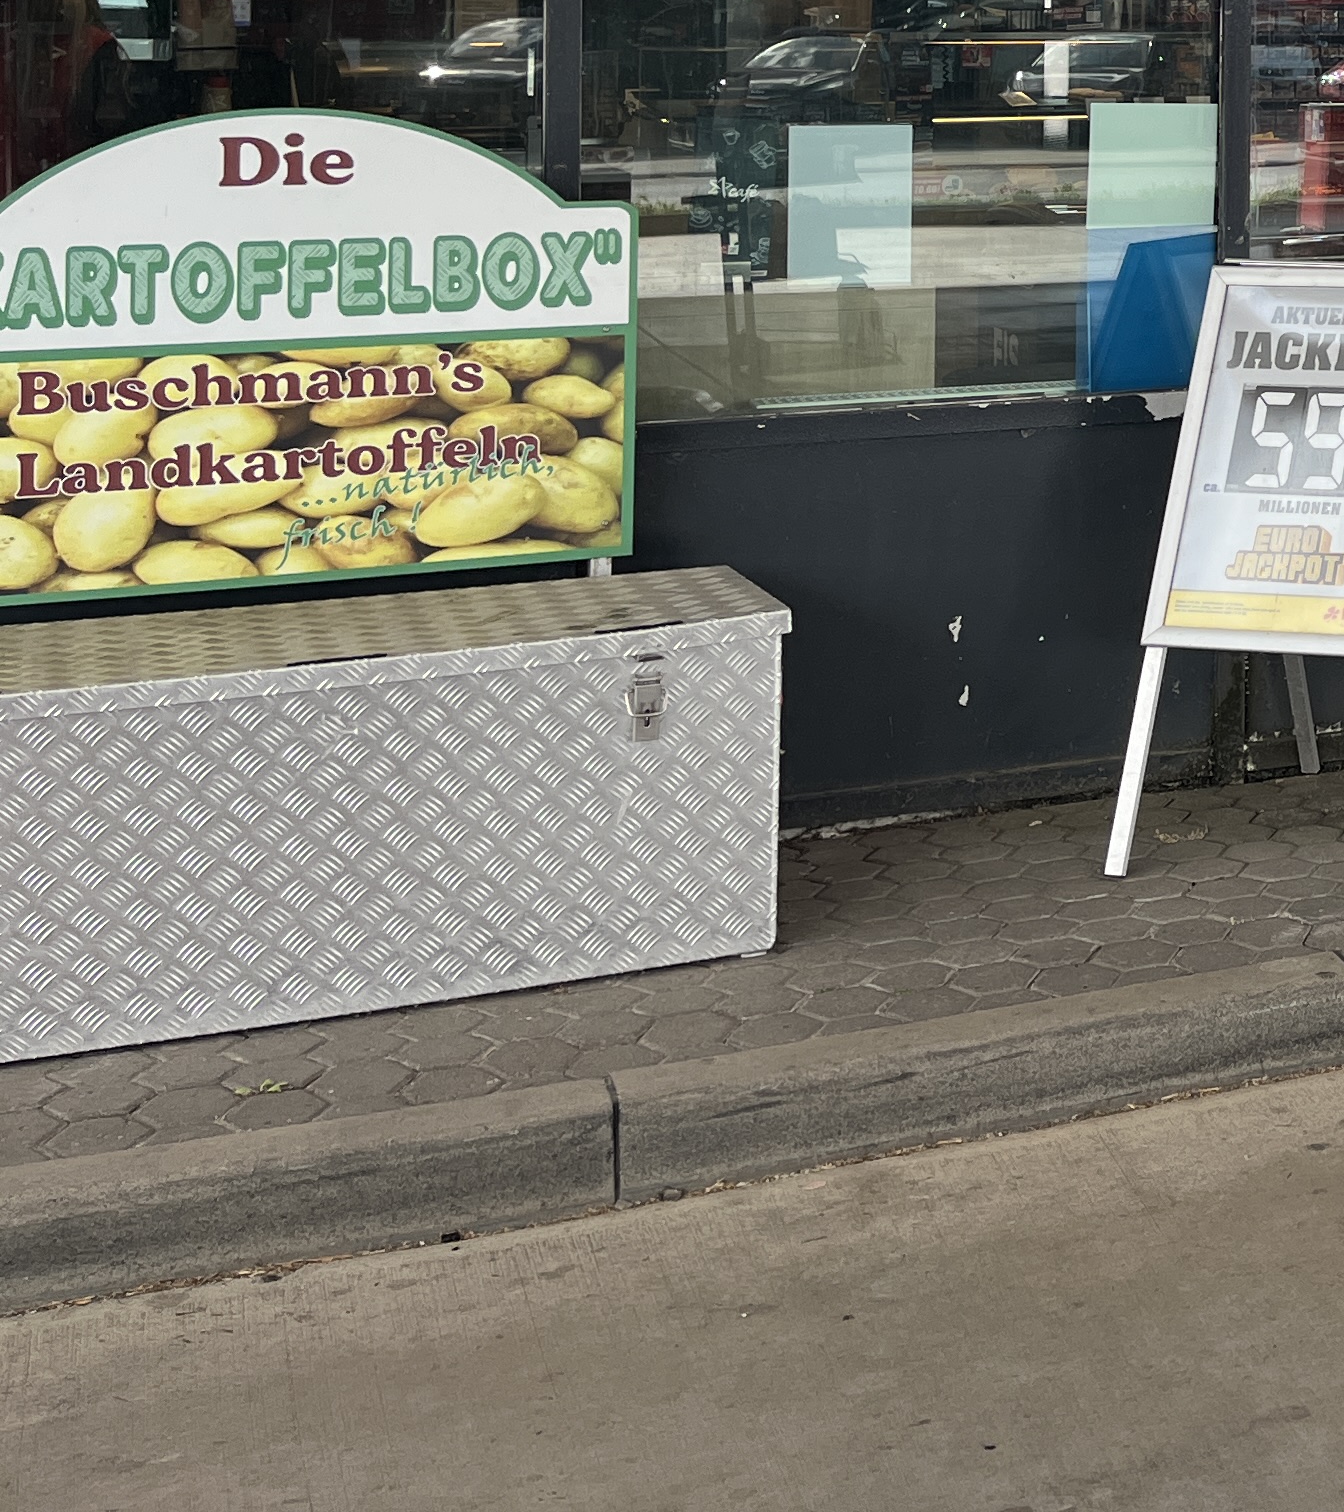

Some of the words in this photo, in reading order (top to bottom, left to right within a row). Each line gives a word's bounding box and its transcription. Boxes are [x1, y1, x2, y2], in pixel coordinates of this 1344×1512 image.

[219, 132, 355, 187] Die
[0, 228, 623, 330] ARTOFFELBOX"
[16, 352, 485, 417] Buschmann's
[15, 426, 542, 500] Landkartoffeln
[1258, 500, 1342, 516] MILLIONEN
[276, 513, 396, 569] frisch
[1253, 525, 1324, 554] EURO
